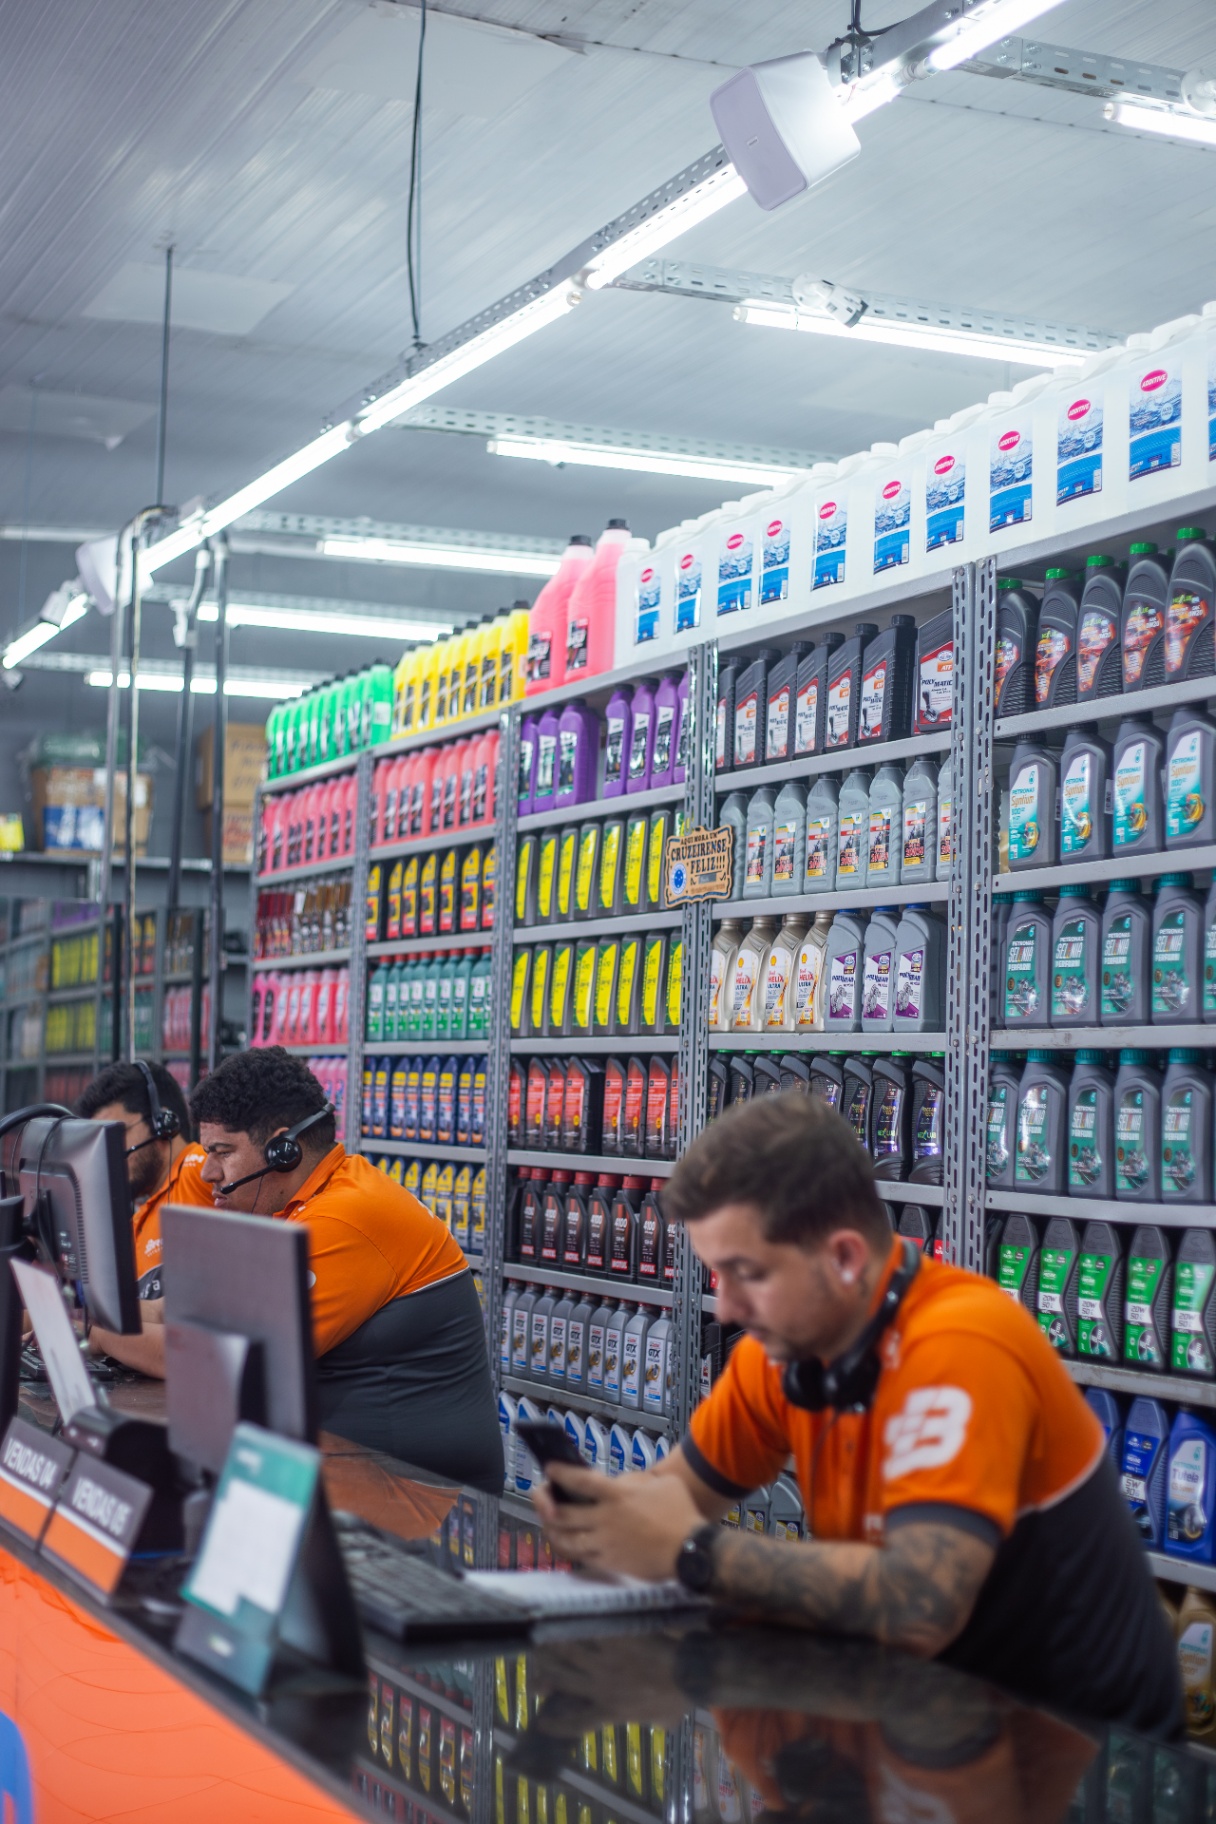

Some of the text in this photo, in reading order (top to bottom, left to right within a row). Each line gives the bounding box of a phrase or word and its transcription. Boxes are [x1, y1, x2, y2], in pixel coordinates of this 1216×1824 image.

[1141, 373, 1167, 389] ADDITIVE
[1068, 403, 1090, 417] ADDITIVE
[999, 435, 1020, 448] ADDITIVE
[921, 678, 953, 688] POLY MATIC
[1171, 755, 1197, 764] PETRONAS
[1117, 766, 1141, 775] PETRONAS
[1011, 787, 1035, 795] PETRONAS
[680, 837, 694, 845] AQUI
[694, 834, 709, 843] MORA
[671, 838, 727, 862] CRUZEIRENSE
[690, 855, 726, 874] FELIZ!!!
[1103, 956, 1127, 965] PERFORM
[1154, 952, 1180, 962] PERFORM
[1007, 962, 1031, 971] PERFORM
[1054, 959, 1081, 968] PERFORM
[735, 975, 751, 984] HELIX
[767, 973, 784, 983] HELIX
[799, 971, 814, 981] HELIX
[1071, 1129, 1093, 1138] PERFORM
[1117, 1132, 1140, 1141] PERFORM
[614, 1218, 628, 1228] 4100
[643, 1220, 656, 1231] 4100
[611, 1260, 628, 1270] MOTUL
[640, 1264, 656, 1273] MOTUL
[1131, 1306, 1147, 1314] 20W
[1179, 1312, 1195, 1320] 20W
[591, 1335, 602, 1344] GTX
[607, 1339, 618, 1348] GTX
[626, 1344, 637, 1353] GTX
[648, 1348, 661, 1358] GTX
[3, 1437, 58, 1490] VENDAS 04
[1172, 1468, 1200, 1483] Tutela
[1126, 1479, 1141, 1488] 5W
[1125, 1487, 1135, 1496] 30
[72, 1477, 133, 1536] VENDAS 05
